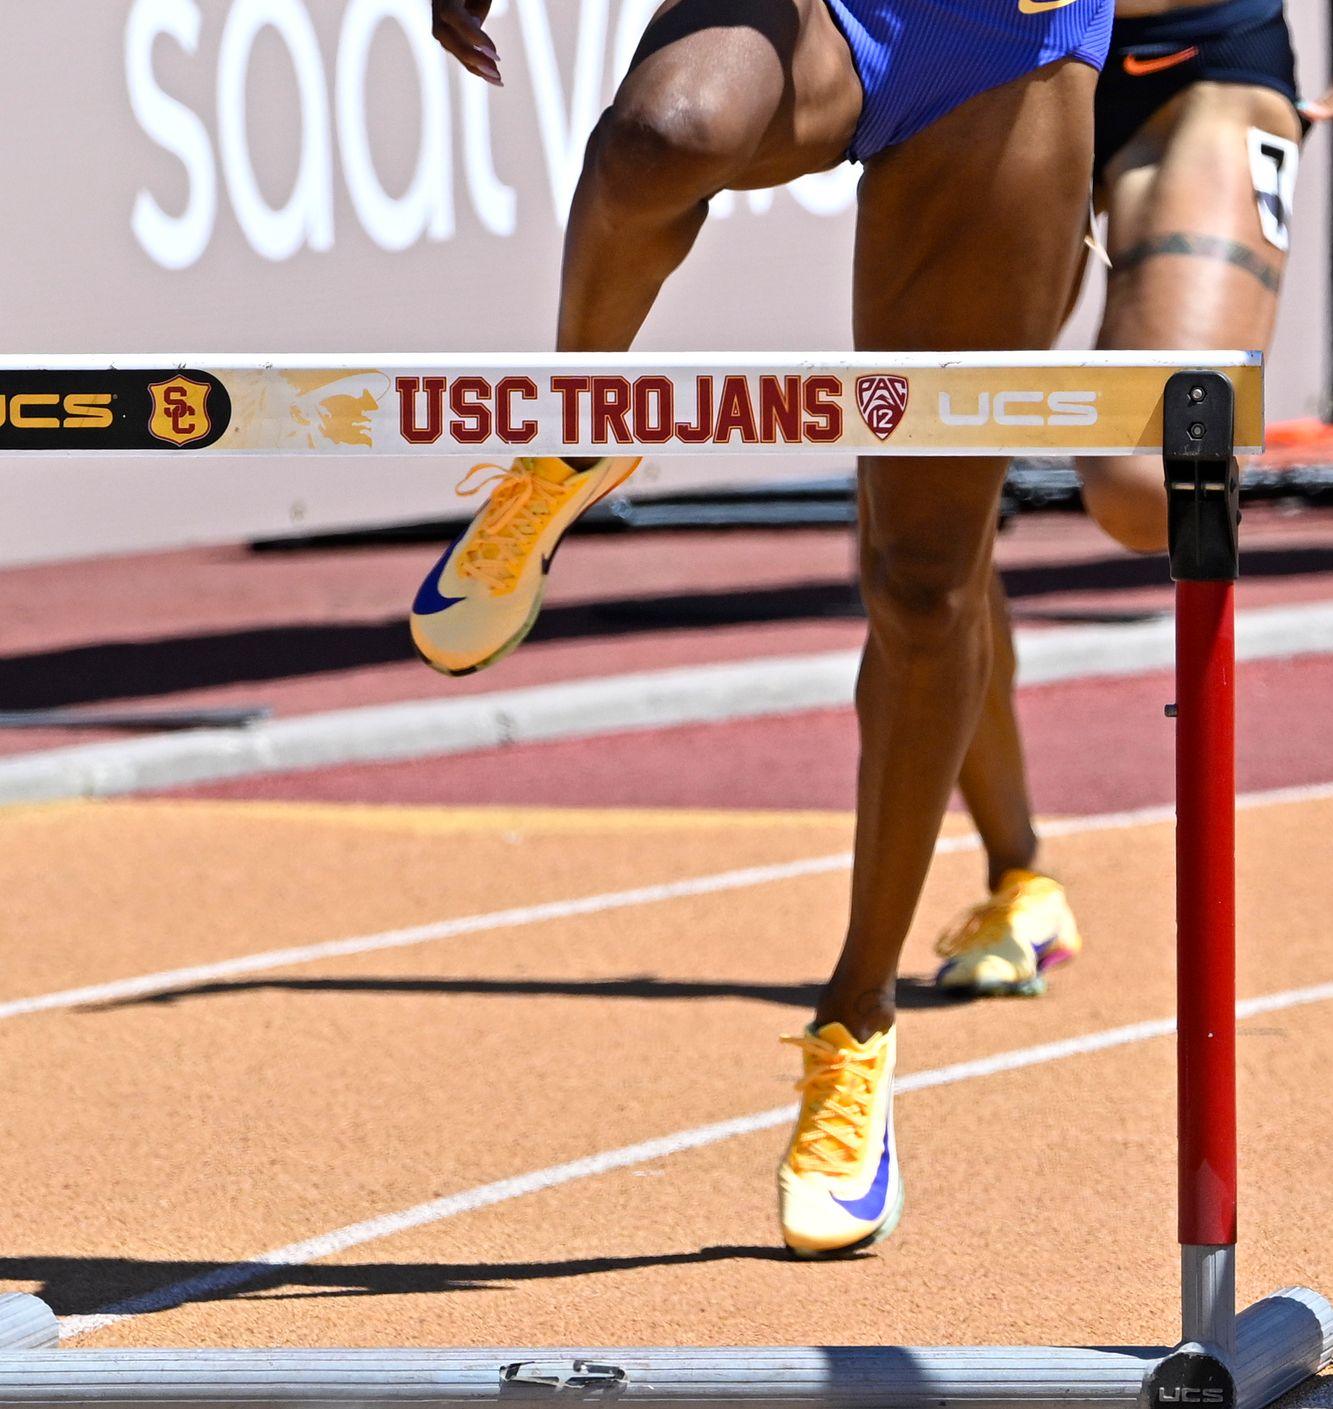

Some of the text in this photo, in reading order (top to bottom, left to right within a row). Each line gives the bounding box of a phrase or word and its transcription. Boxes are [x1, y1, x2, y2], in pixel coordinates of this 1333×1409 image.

[0, 394, 113, 428] CS
[395, 375, 843, 444] USC TROJANS
[873, 408, 893, 428] 12
[938, 391, 1098, 427] UCS
[1158, 1386, 1224, 1404] UCS
